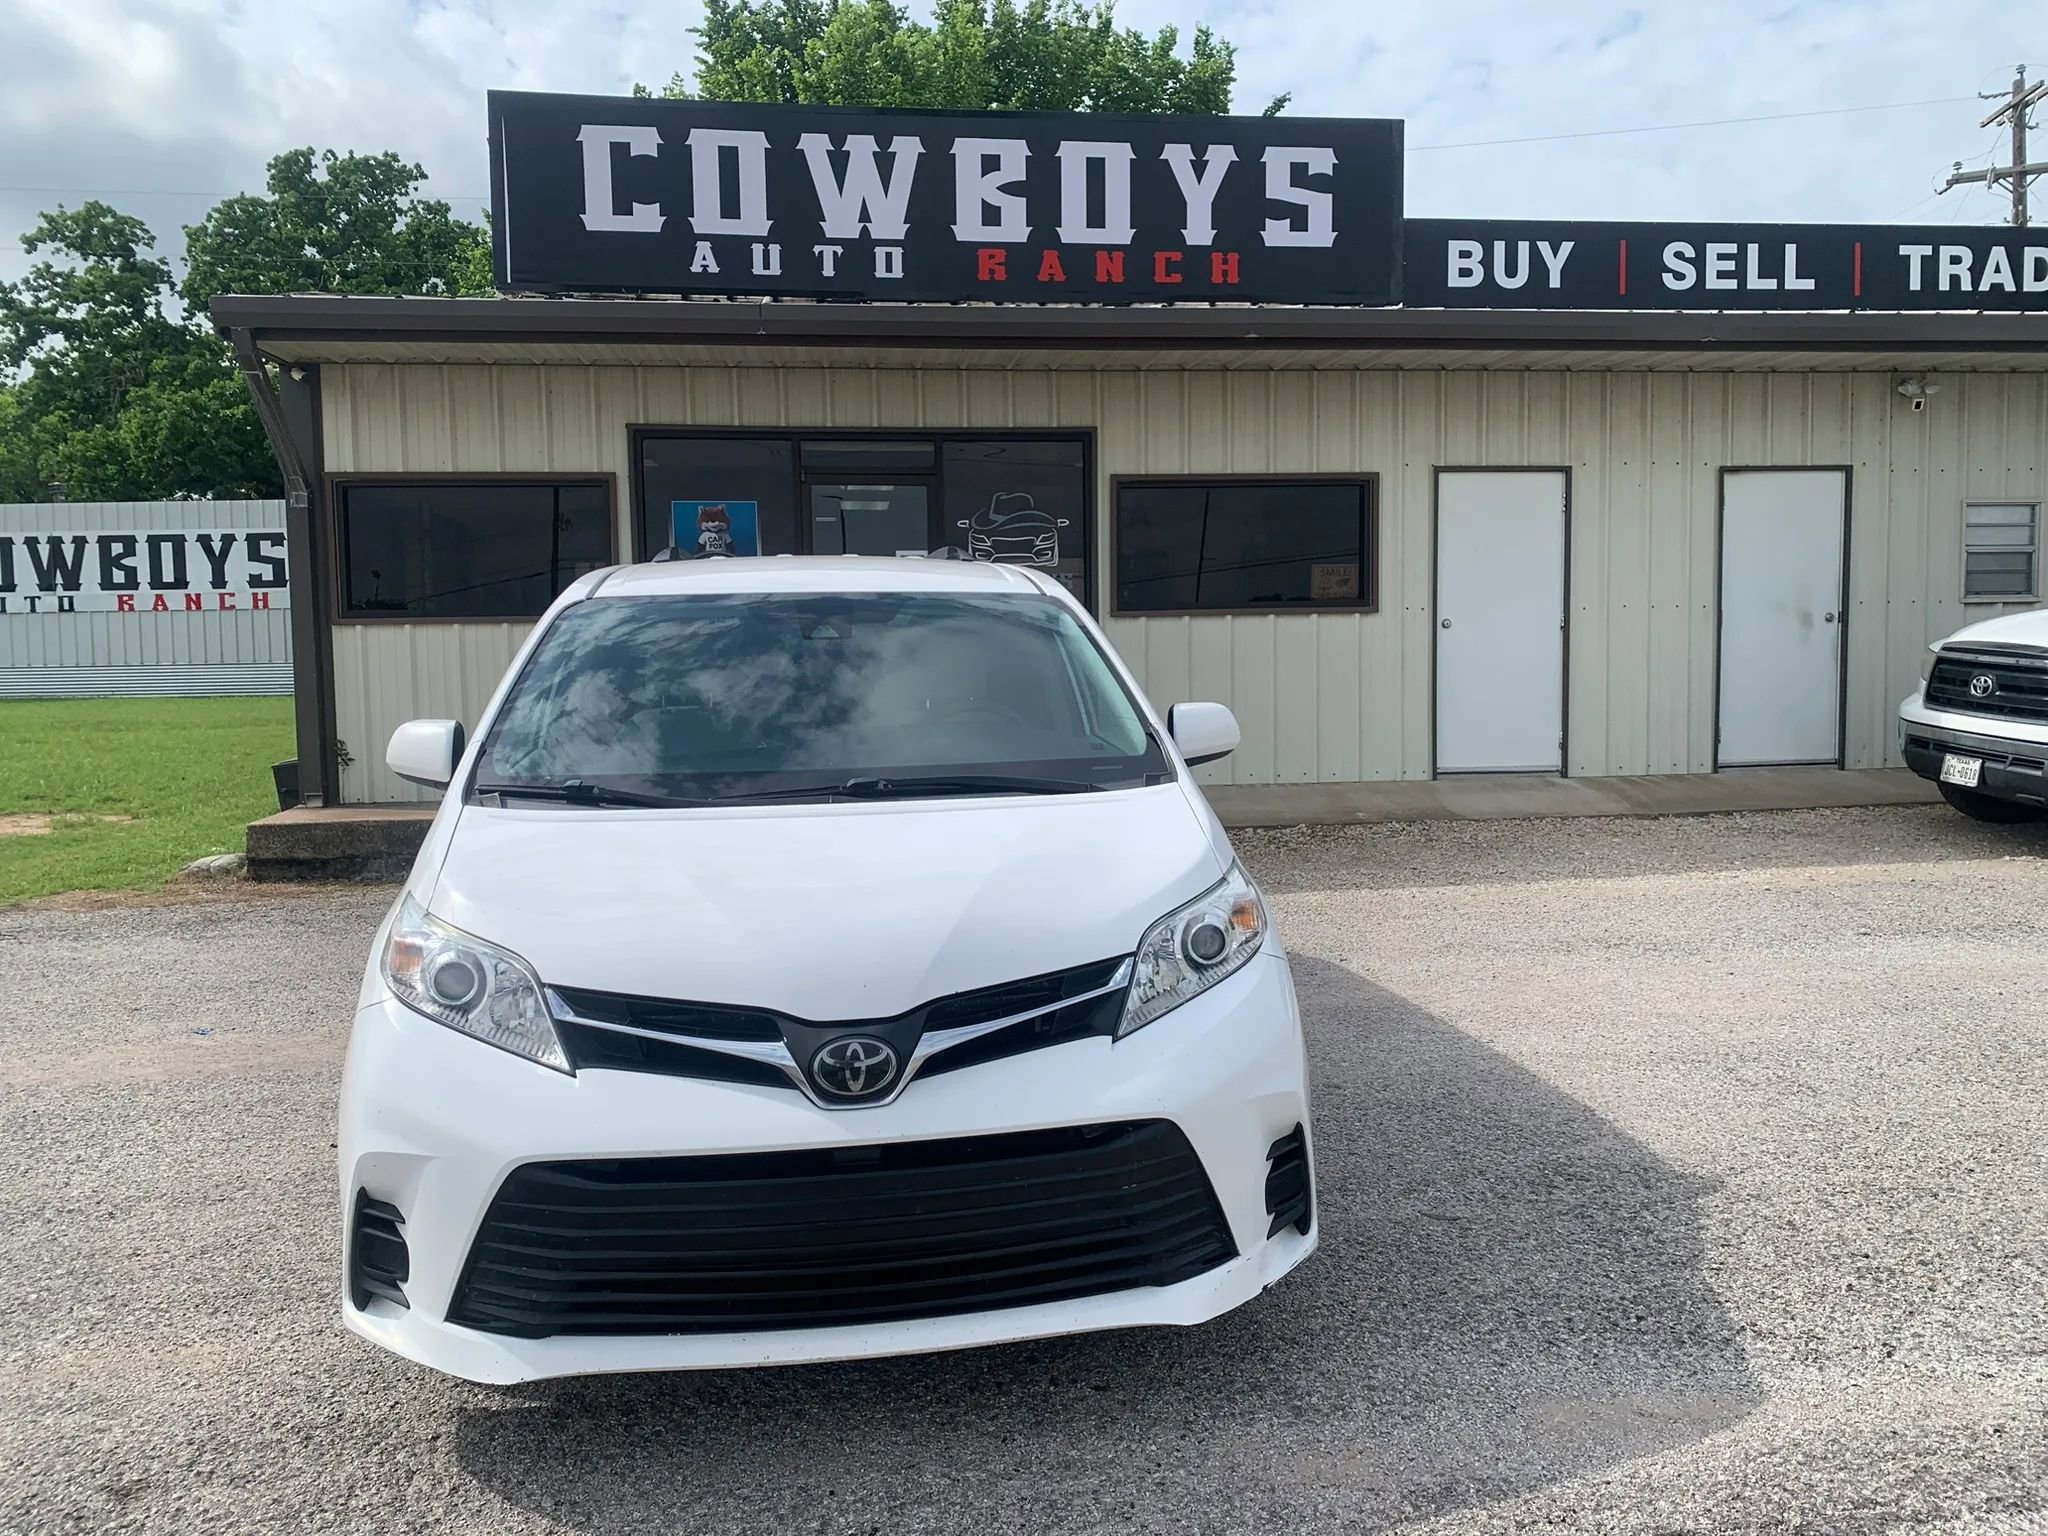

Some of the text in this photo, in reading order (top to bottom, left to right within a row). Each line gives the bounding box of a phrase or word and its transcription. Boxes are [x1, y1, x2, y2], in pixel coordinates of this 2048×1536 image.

[575, 123, 1339, 247] COWBOYS
[689, 240, 1240, 284] AUTO RANCH
[1447, 239, 1575, 289] BUY
[1661, 241, 1816, 292] SELL
[117, 592, 269, 612] RANCH
